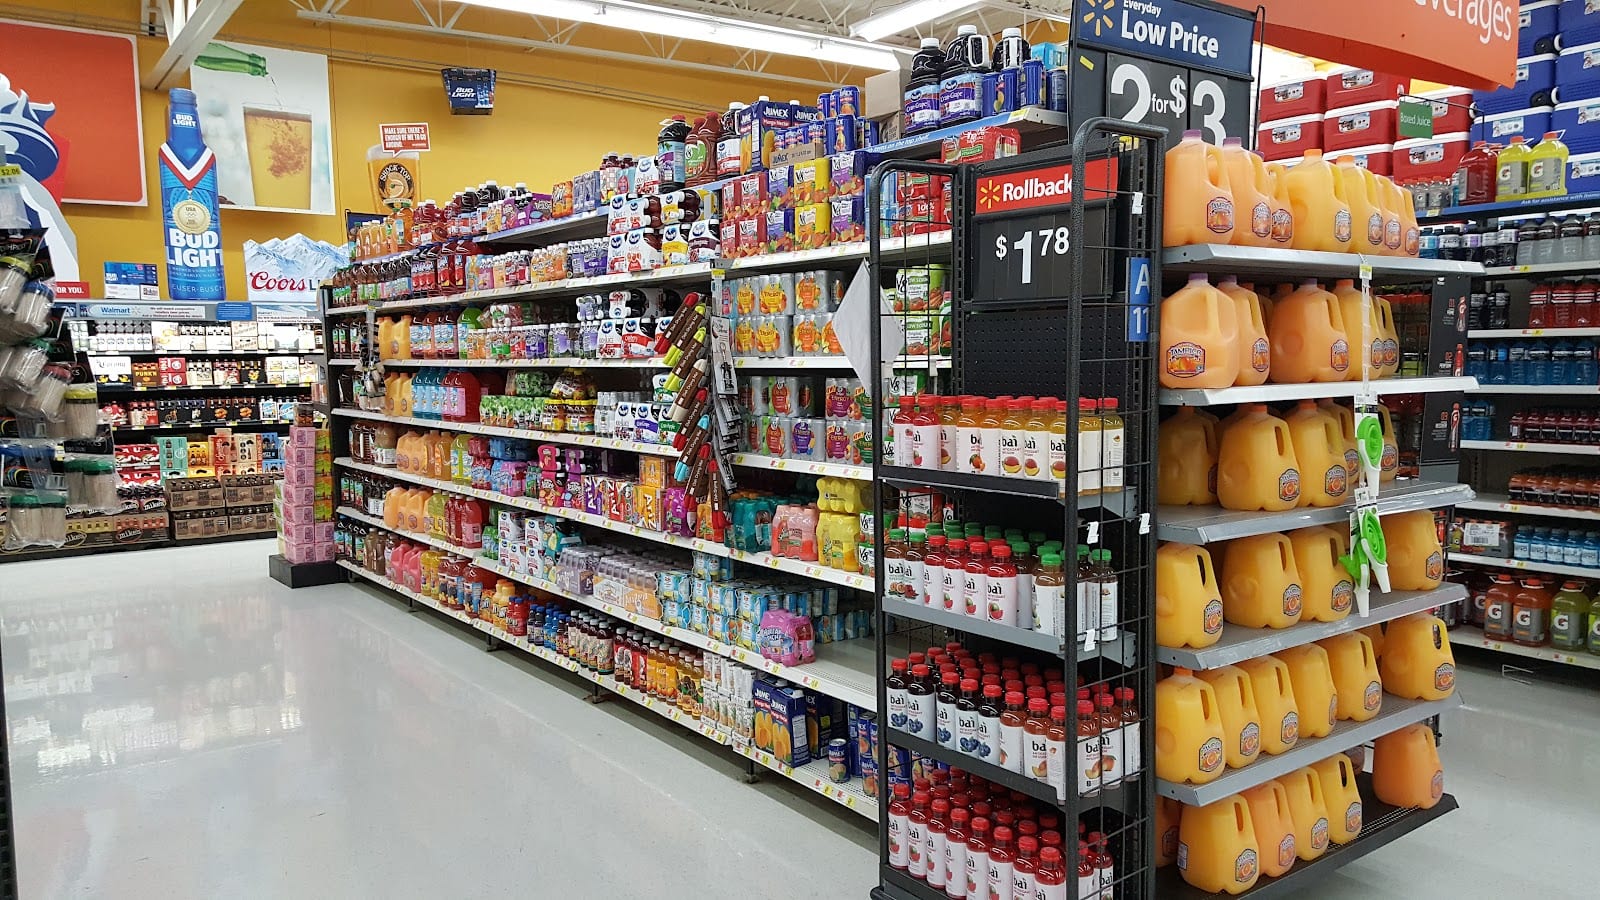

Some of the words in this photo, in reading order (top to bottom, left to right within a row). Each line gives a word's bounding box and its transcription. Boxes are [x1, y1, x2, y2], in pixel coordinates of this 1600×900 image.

[1121, 10, 1166, 46] Low
[1169, 21, 1219, 58] Price
[1111, 63, 1151, 123] 2
[1152, 94, 1169, 114] for
[764, 106, 788, 117] JUMEX
[795, 110, 818, 121] JUMEX
[173, 119, 196, 127] LIGHT
[1400, 112, 1415, 124] Boxed
[1415, 114, 1431, 126] Juice
[1500, 165, 1511, 180] G
[1531, 162, 1544, 177] G
[1003, 173, 1072, 201] Rollback
[169, 228, 219, 248] BUD
[166, 246, 224, 268] LIGHT
[250, 271, 308, 291] Coors
[1135, 263, 1150, 295] A
[890, 377, 900, 392] V8
[913, 432, 921, 443] ai
[860, 516, 869, 532] V8
[859, 548, 869, 563] V8
[943, 573, 952, 585] ai
[964, 578, 975, 590] ai
[1488, 605, 1501, 619] G
[1516, 611, 1531, 625] G
[1554, 615, 1568, 630] G
[890, 695, 904, 705] bai
[959, 717, 975, 728] bai
[979, 722, 987, 733] ai
[1032, 740, 1046, 751] ba
